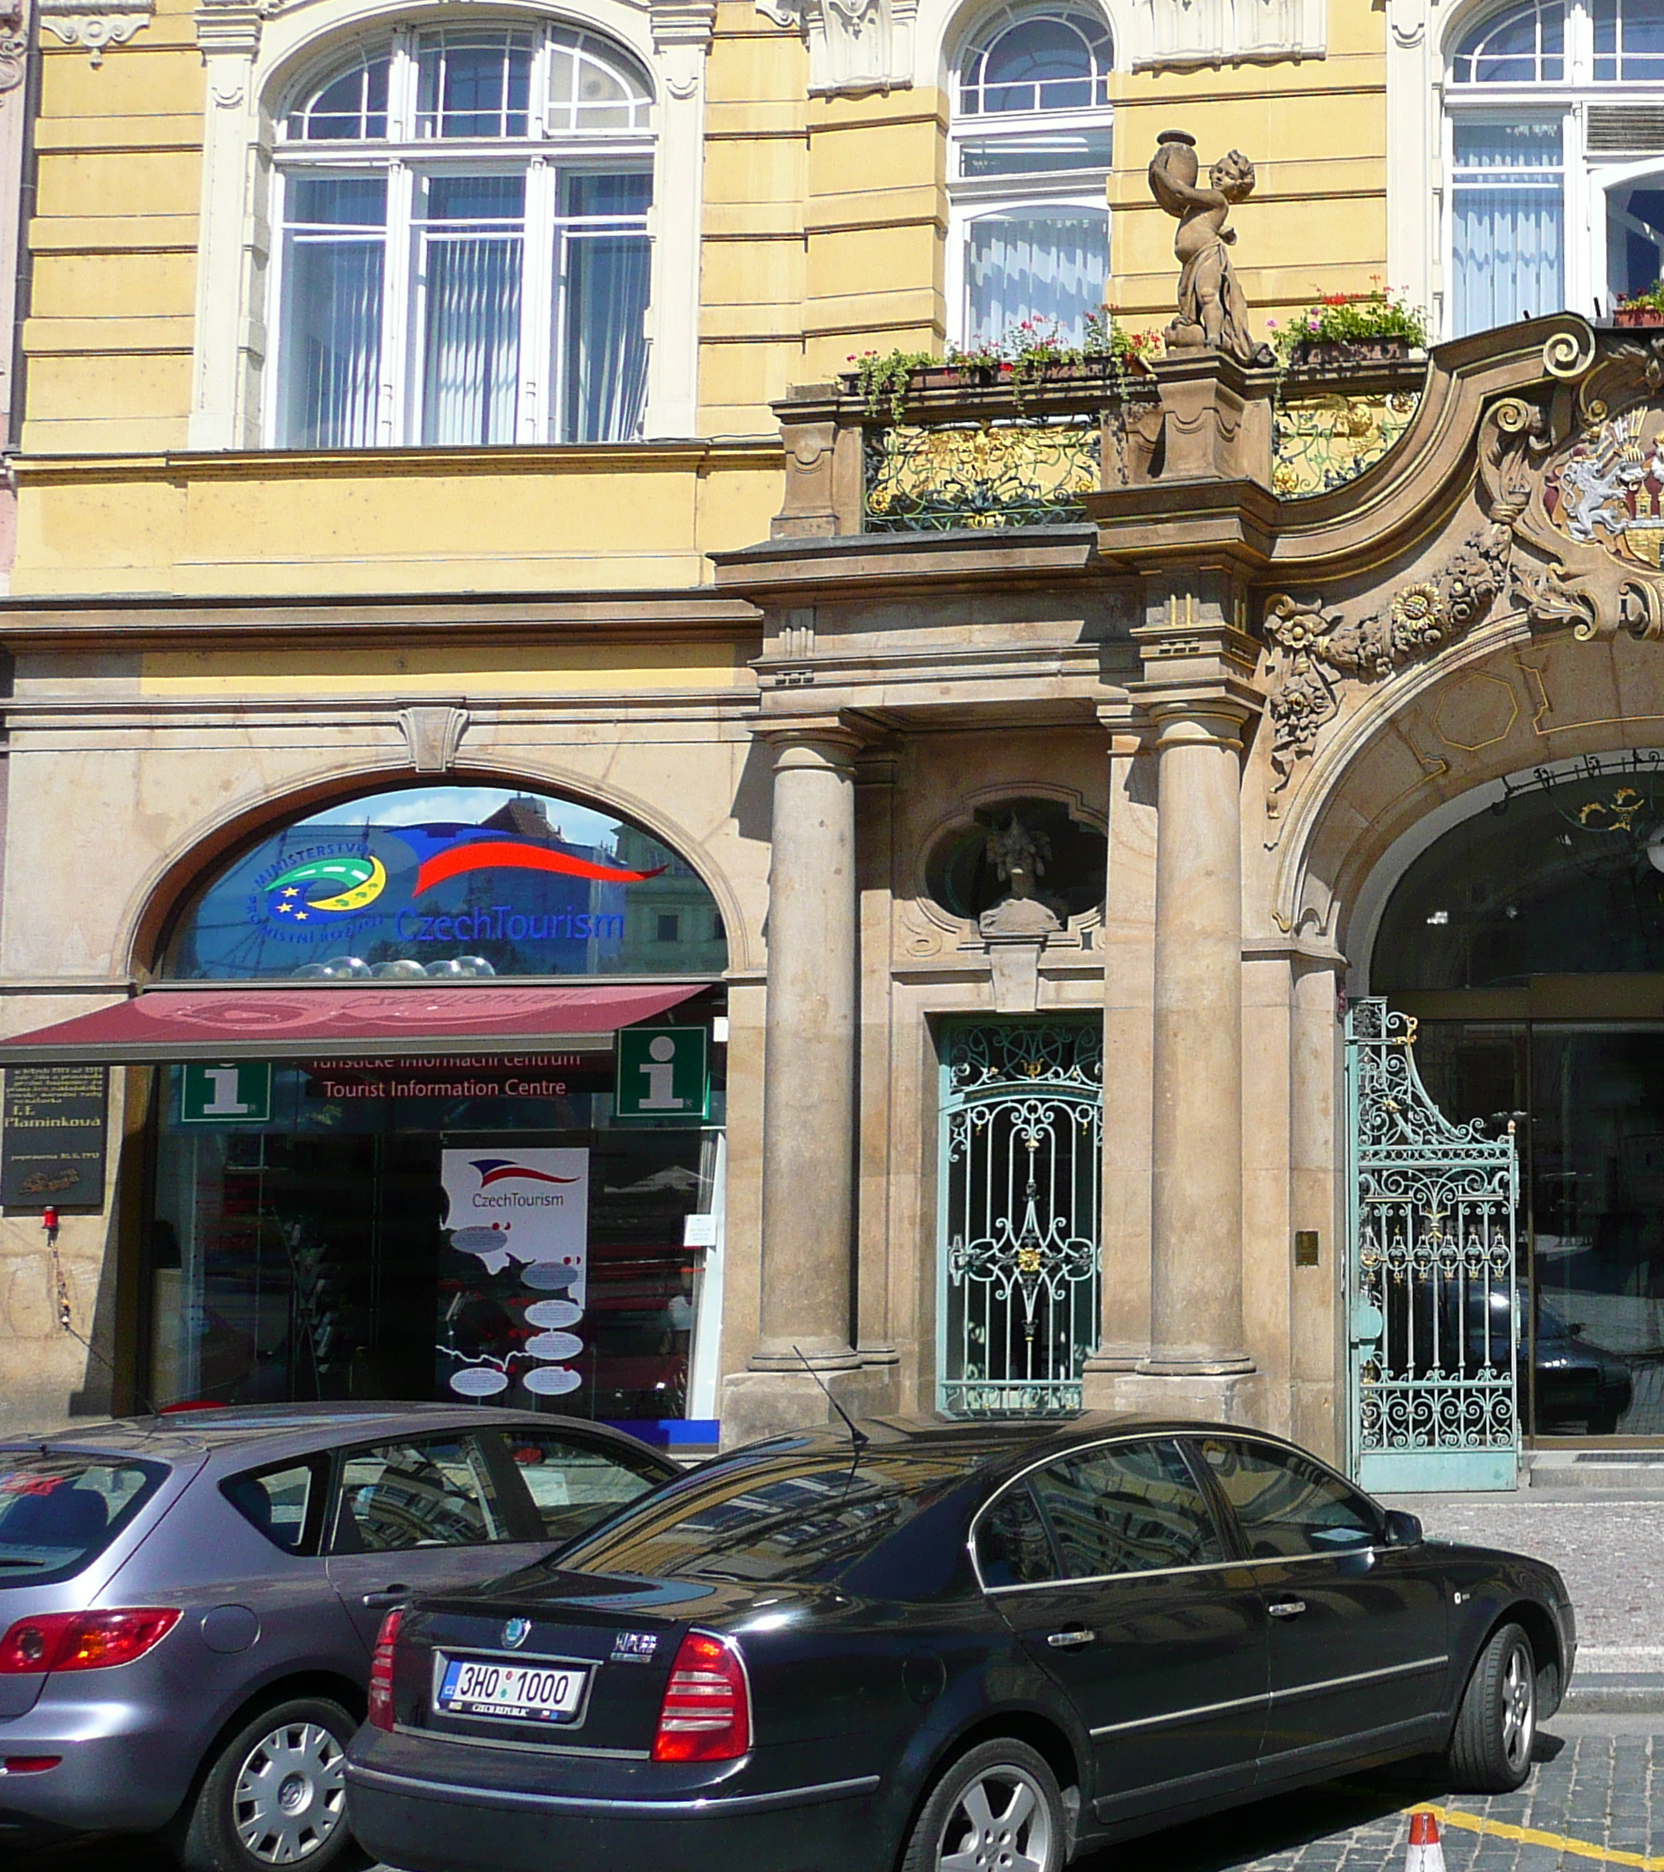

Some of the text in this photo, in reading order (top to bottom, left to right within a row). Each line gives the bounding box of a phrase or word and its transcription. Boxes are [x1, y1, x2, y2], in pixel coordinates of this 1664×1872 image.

[254, 842, 369, 887] MINISTERSTVO
[246, 896, 261, 925] PRO
[396, 906, 624, 941] CzechTourism
[323, 1079, 566, 1097] Tourist Information Centre
[472, 1192, 564, 1208] CzechTourism
[517, 1671, 569, 1705] 1000
[472, 1703, 529, 1717] CZECH REPUBLIC
